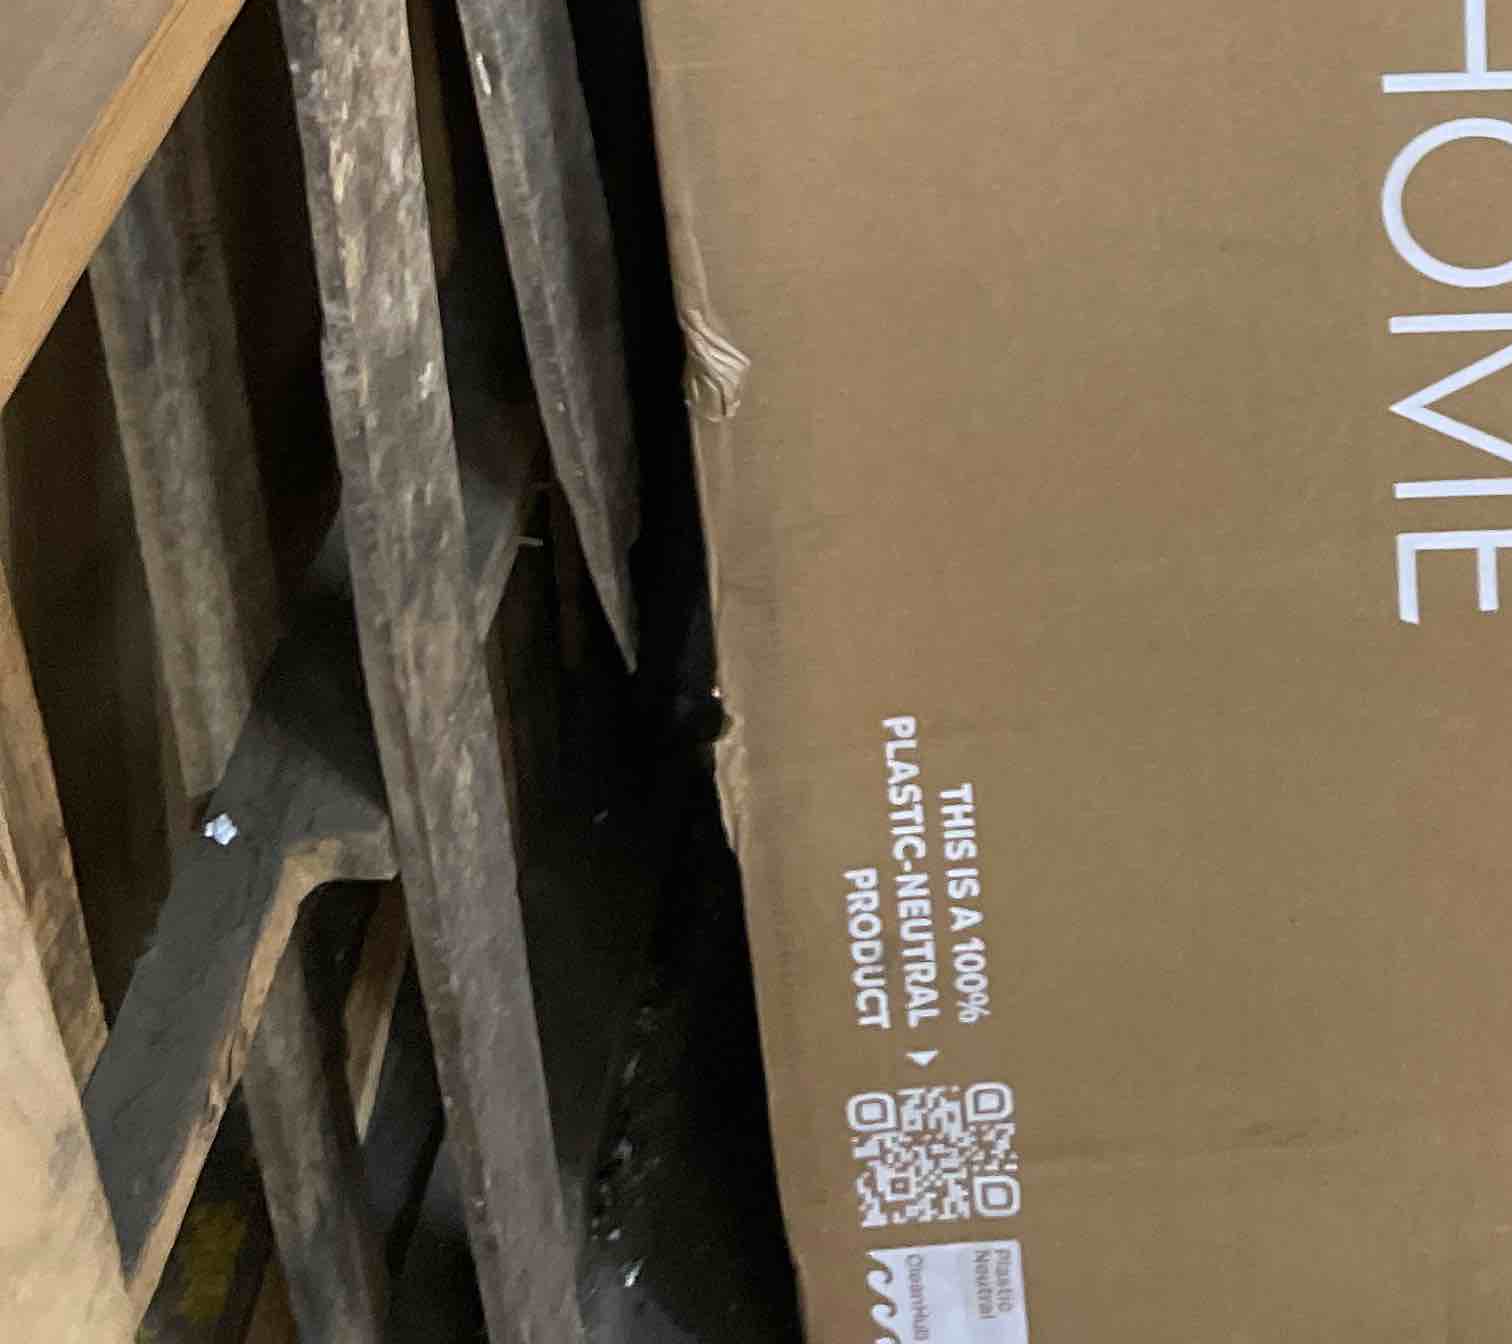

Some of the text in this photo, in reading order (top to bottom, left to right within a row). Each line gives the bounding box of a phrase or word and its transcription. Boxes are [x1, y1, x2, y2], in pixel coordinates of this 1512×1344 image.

[843, 866, 892, 1031] PRODUCT
[881, 714, 941, 1029] PLASTIC-NEUTRAL
[939, 782, 991, 1024] THIS IS A 100%
